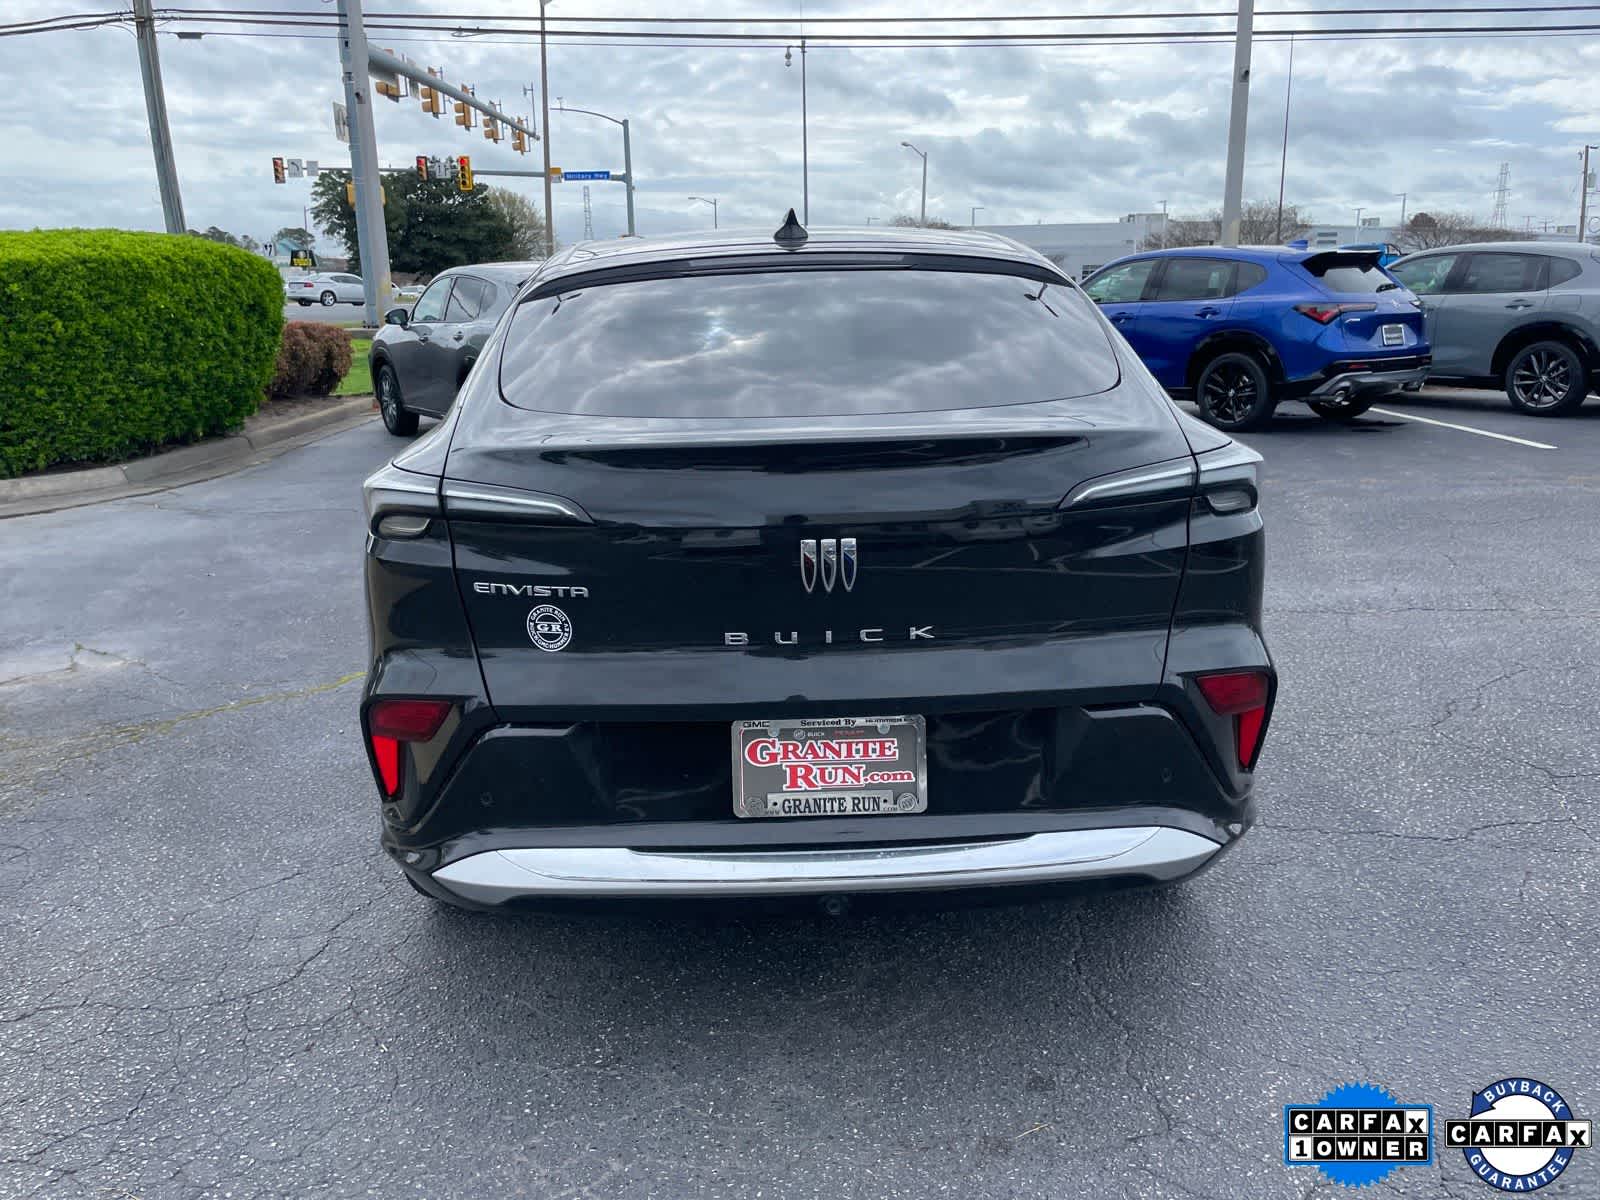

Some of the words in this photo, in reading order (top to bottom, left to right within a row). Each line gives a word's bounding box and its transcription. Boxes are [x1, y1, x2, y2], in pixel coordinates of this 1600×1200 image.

[473, 582, 589, 598] ENVISTA
[530, 607, 554, 621] GRANITE
[554, 610, 566, 622] RUN
[537, 623, 562, 632] GR
[724, 625, 936, 646] BUICK
[742, 721, 770, 729] GMC
[800, 719, 842, 728] Serviced
[843, 718, 857, 728] By
[746, 738, 898, 766] GRANITE
[783, 763, 915, 791] RUN.com
[782, 797, 847, 815] GRANITE
[851, 796, 881, 812] RUN
